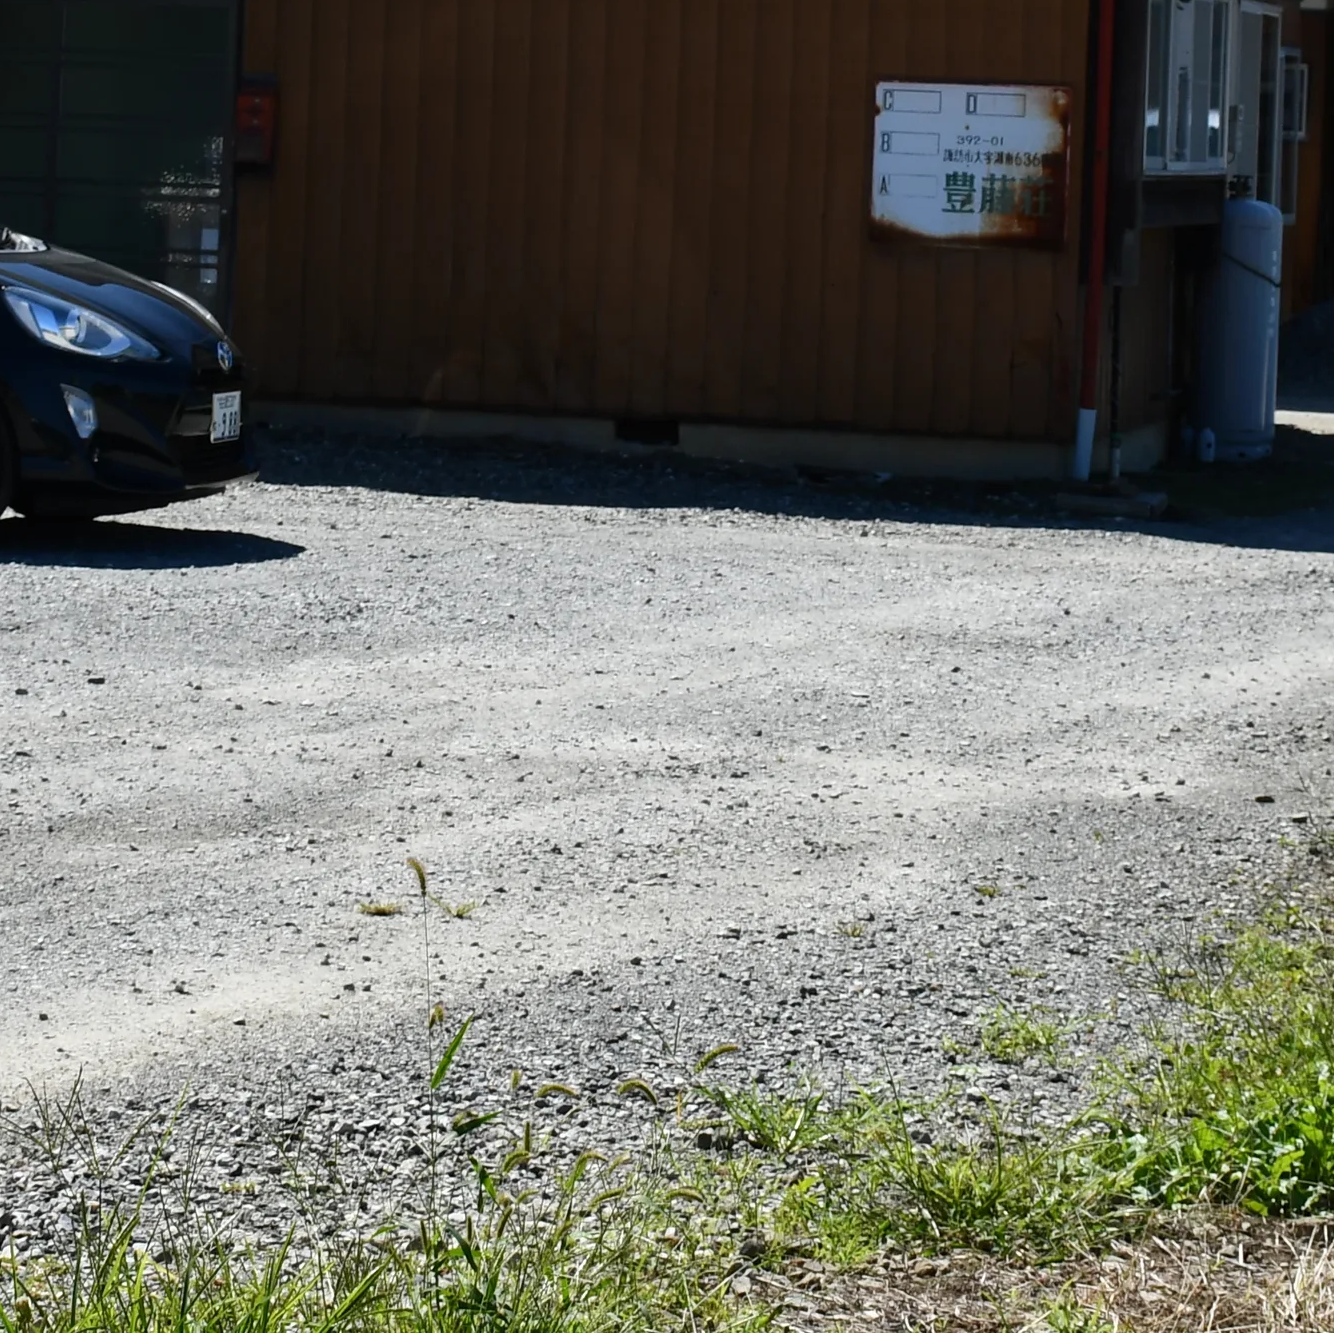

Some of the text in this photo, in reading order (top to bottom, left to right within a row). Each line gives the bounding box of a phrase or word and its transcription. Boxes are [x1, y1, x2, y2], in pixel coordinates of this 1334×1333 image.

[883, 90, 893, 111] C
[881, 132, 890, 153] B
[956, 134, 1004, 147] 392-01
[879, 174, 888, 195] A
